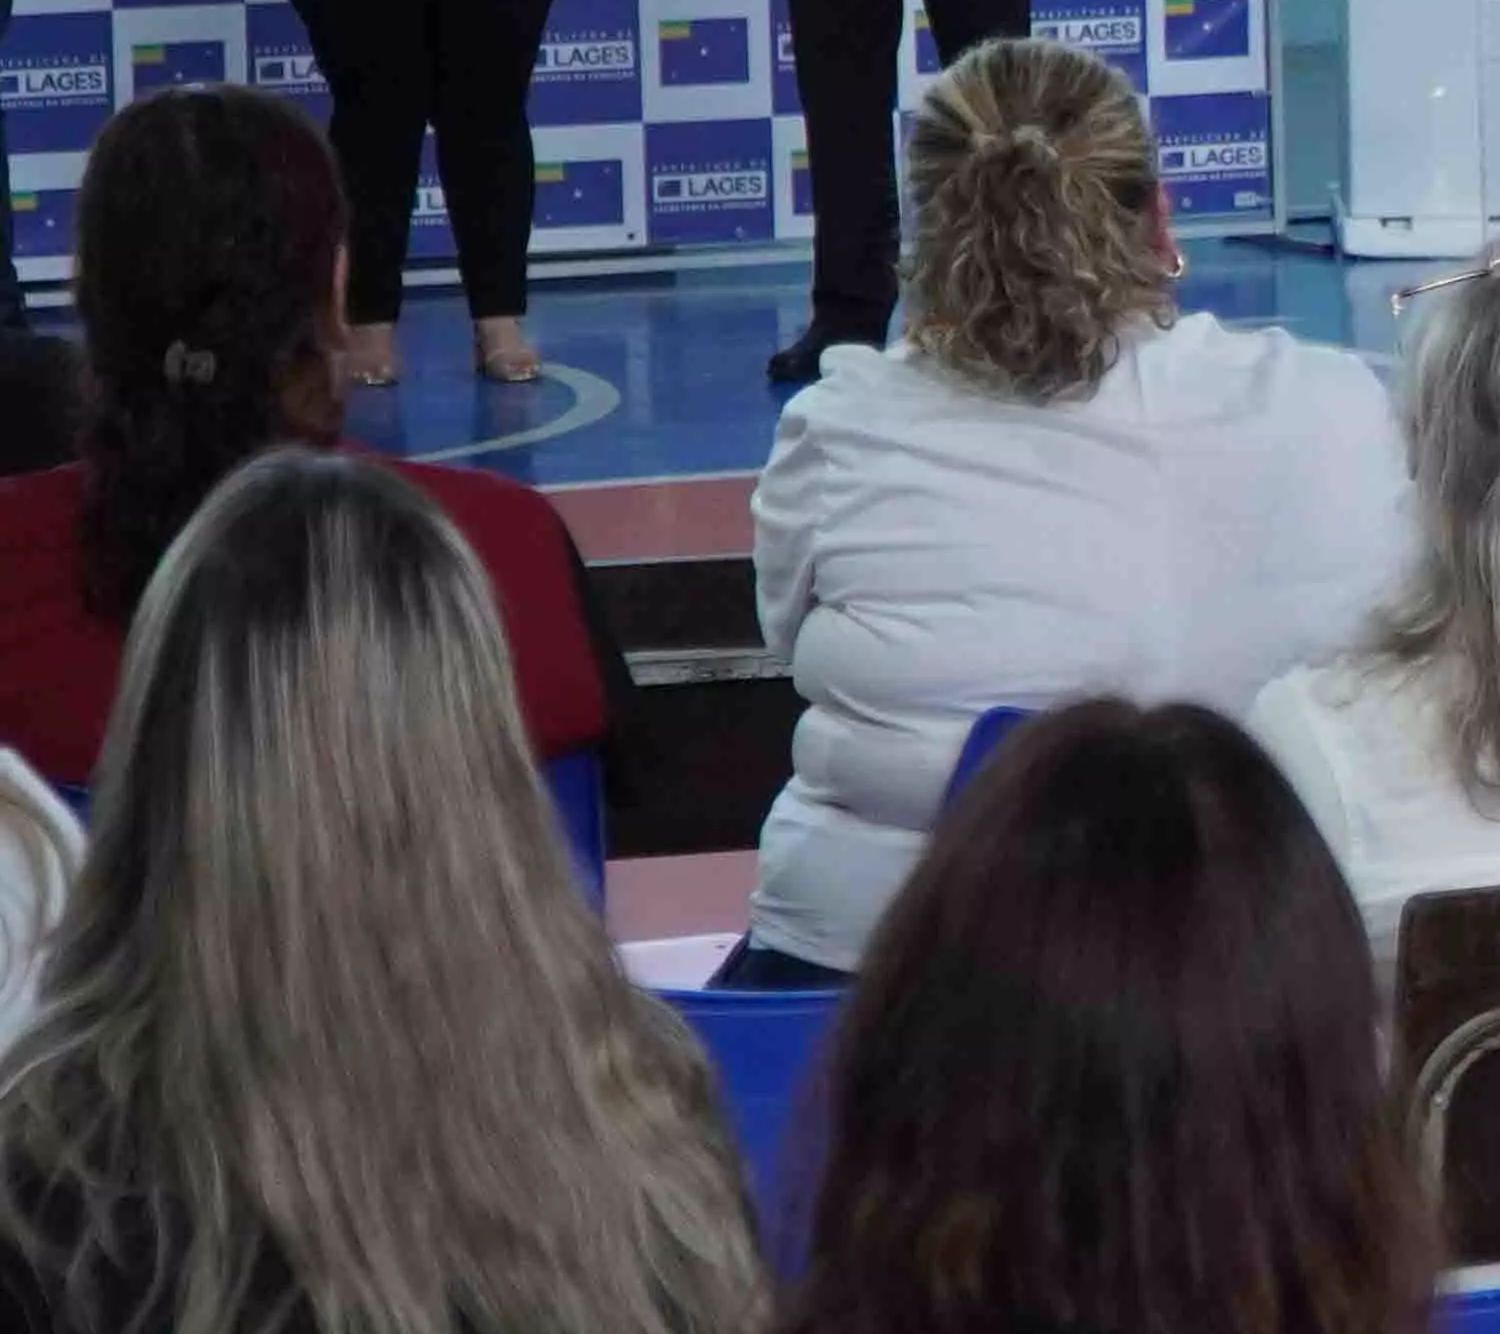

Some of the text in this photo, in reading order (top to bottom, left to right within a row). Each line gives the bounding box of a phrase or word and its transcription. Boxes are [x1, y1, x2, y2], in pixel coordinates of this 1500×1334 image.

[1065, 21, 1136, 42] LAGES
[555, 45, 628, 66] LAGES
[26, 70, 102, 92] LAGES
[1192, 145, 1261, 167] LAGES
[689, 174, 761, 196] LAGES
